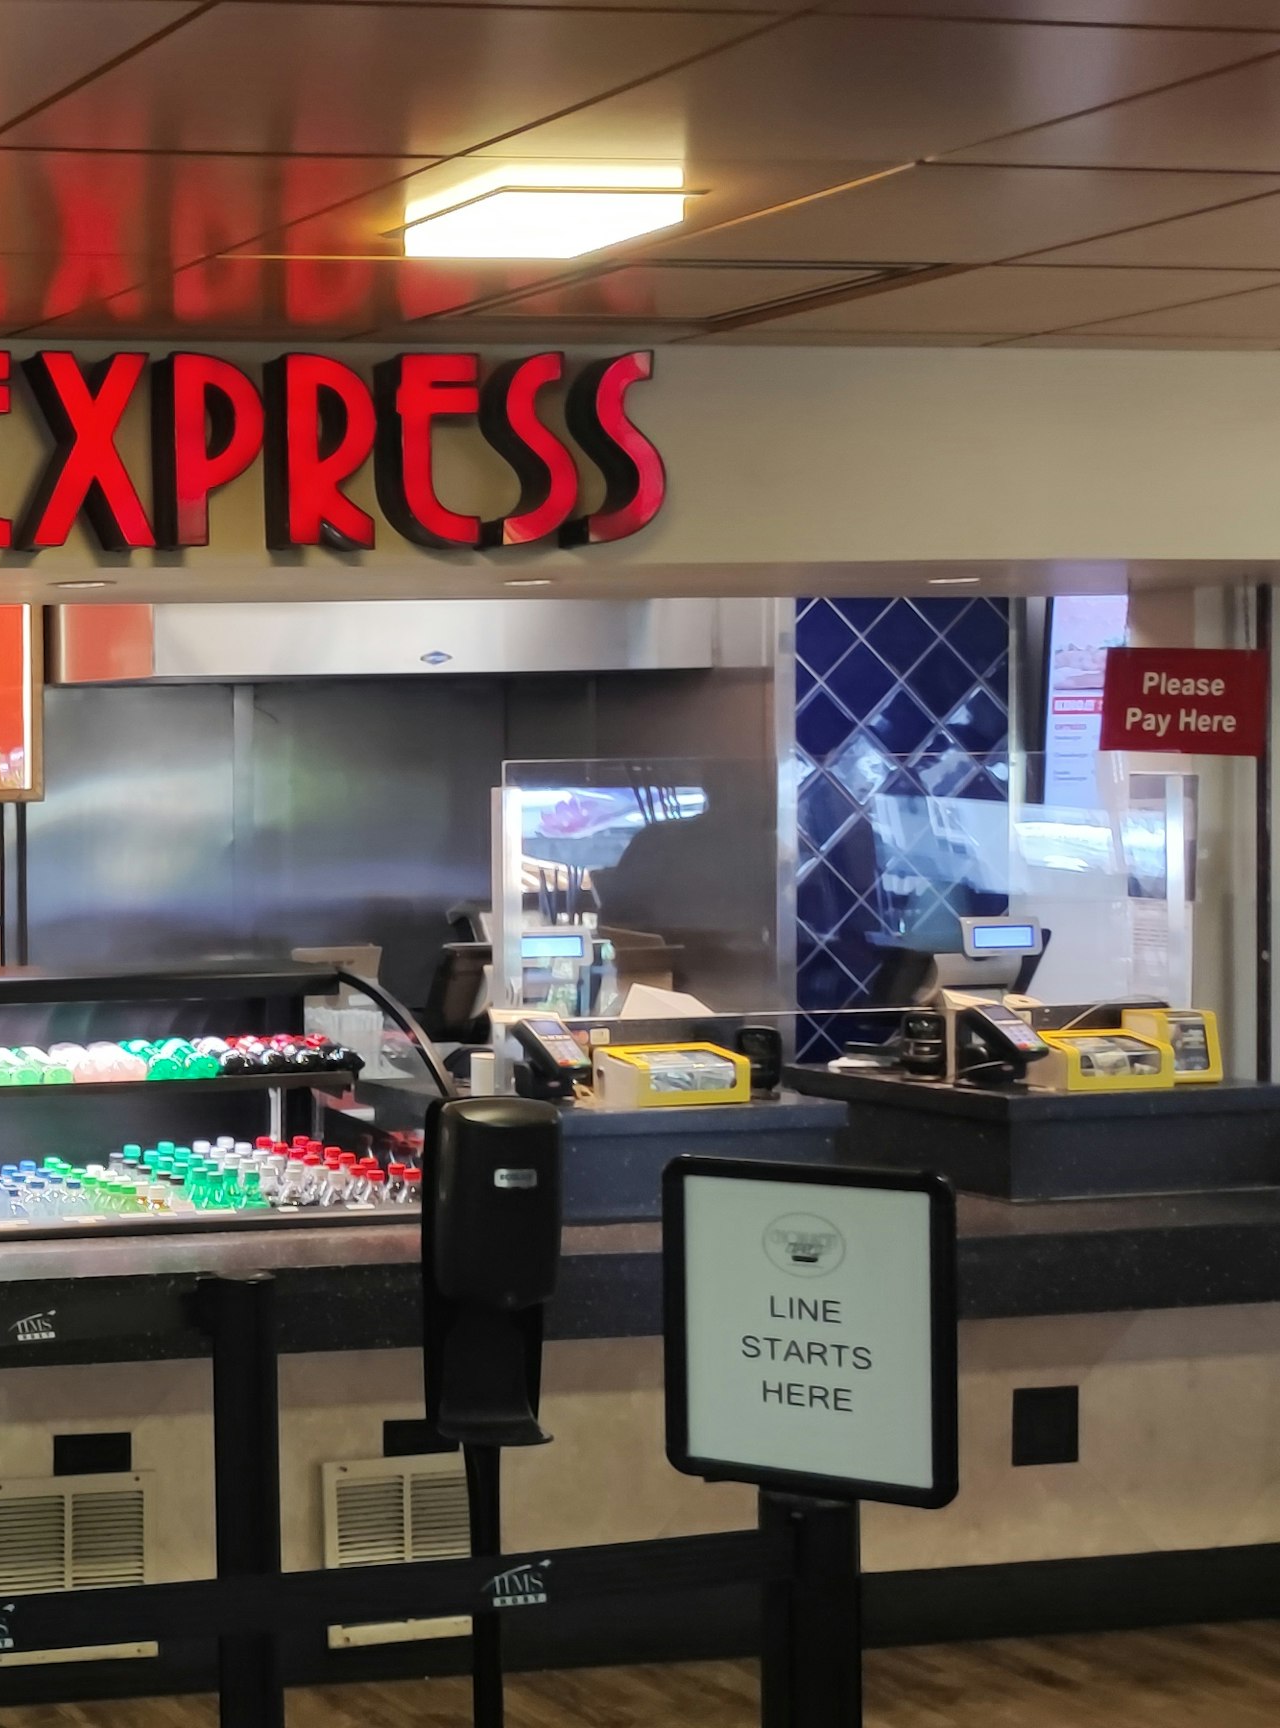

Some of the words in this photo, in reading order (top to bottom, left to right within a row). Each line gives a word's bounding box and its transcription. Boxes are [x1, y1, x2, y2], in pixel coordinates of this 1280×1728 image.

[1142, 671, 1226, 696] Please
[1125, 707, 1171, 737] Pay
[1179, 708, 1237, 732] Here
[768, 1295, 842, 1324] LINE
[741, 1335, 874, 1371] STARTS
[762, 1380, 854, 1413] HERE
